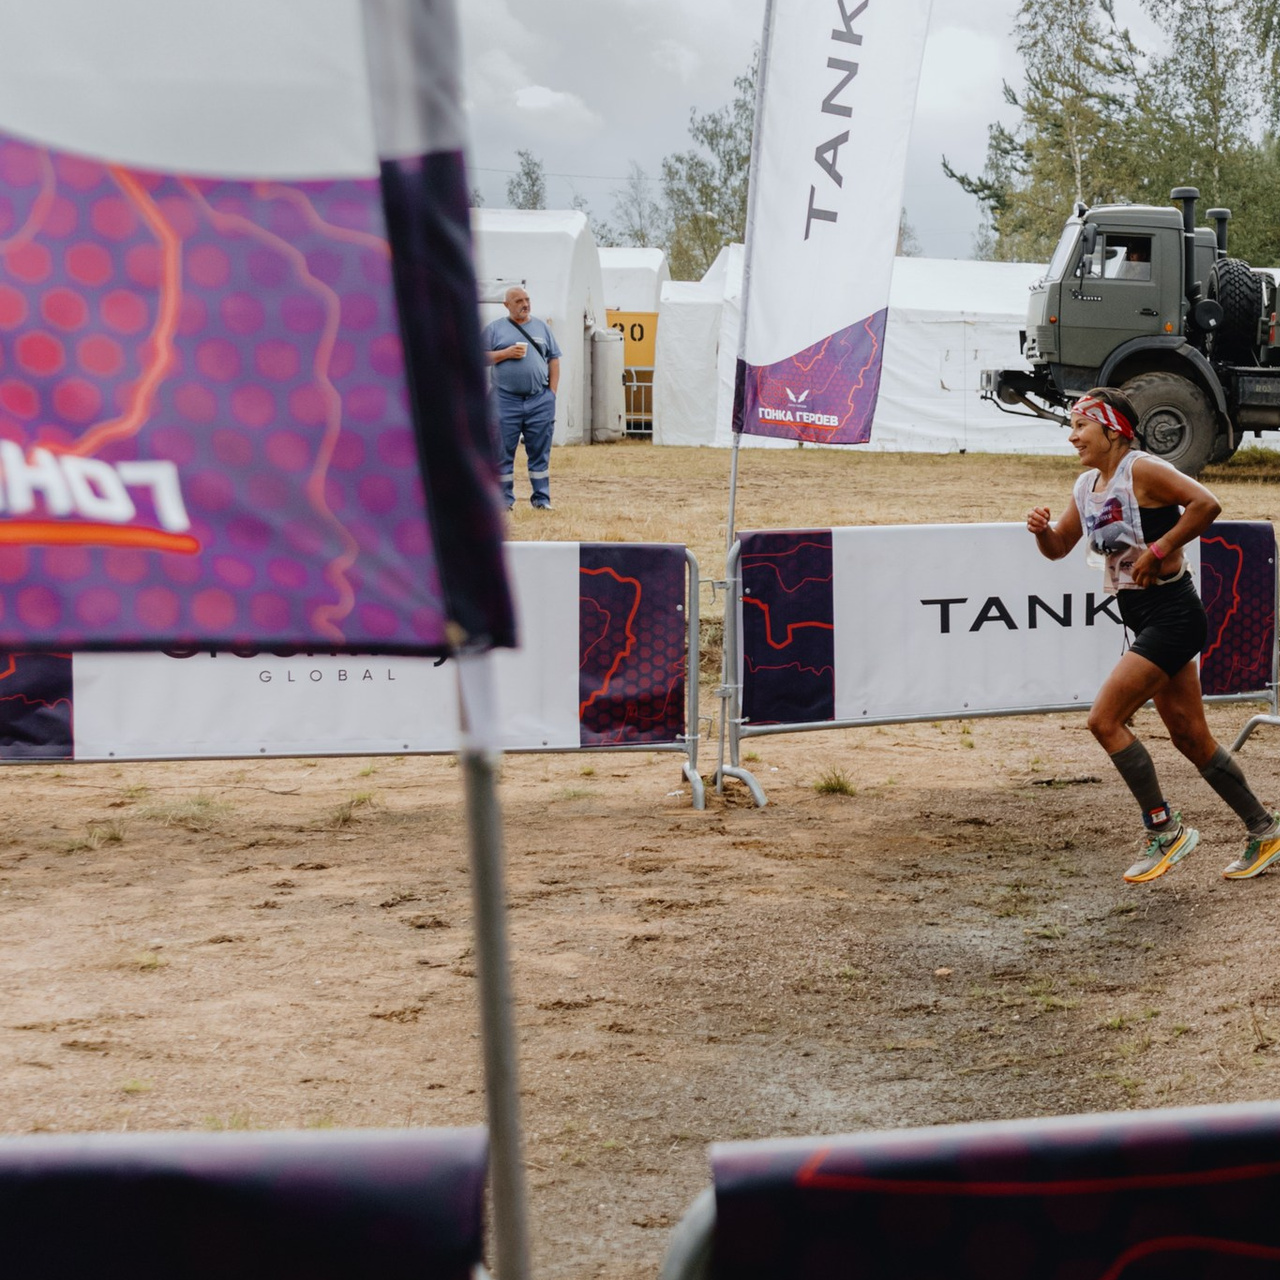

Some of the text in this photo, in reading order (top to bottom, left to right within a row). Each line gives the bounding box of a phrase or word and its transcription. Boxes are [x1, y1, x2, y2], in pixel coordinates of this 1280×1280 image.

[758, 407, 839, 426] ГОНКА ГЕРОЕВ
[919, 592, 1124, 634] TANK
[258, 668, 396, 683] GLOBAL
